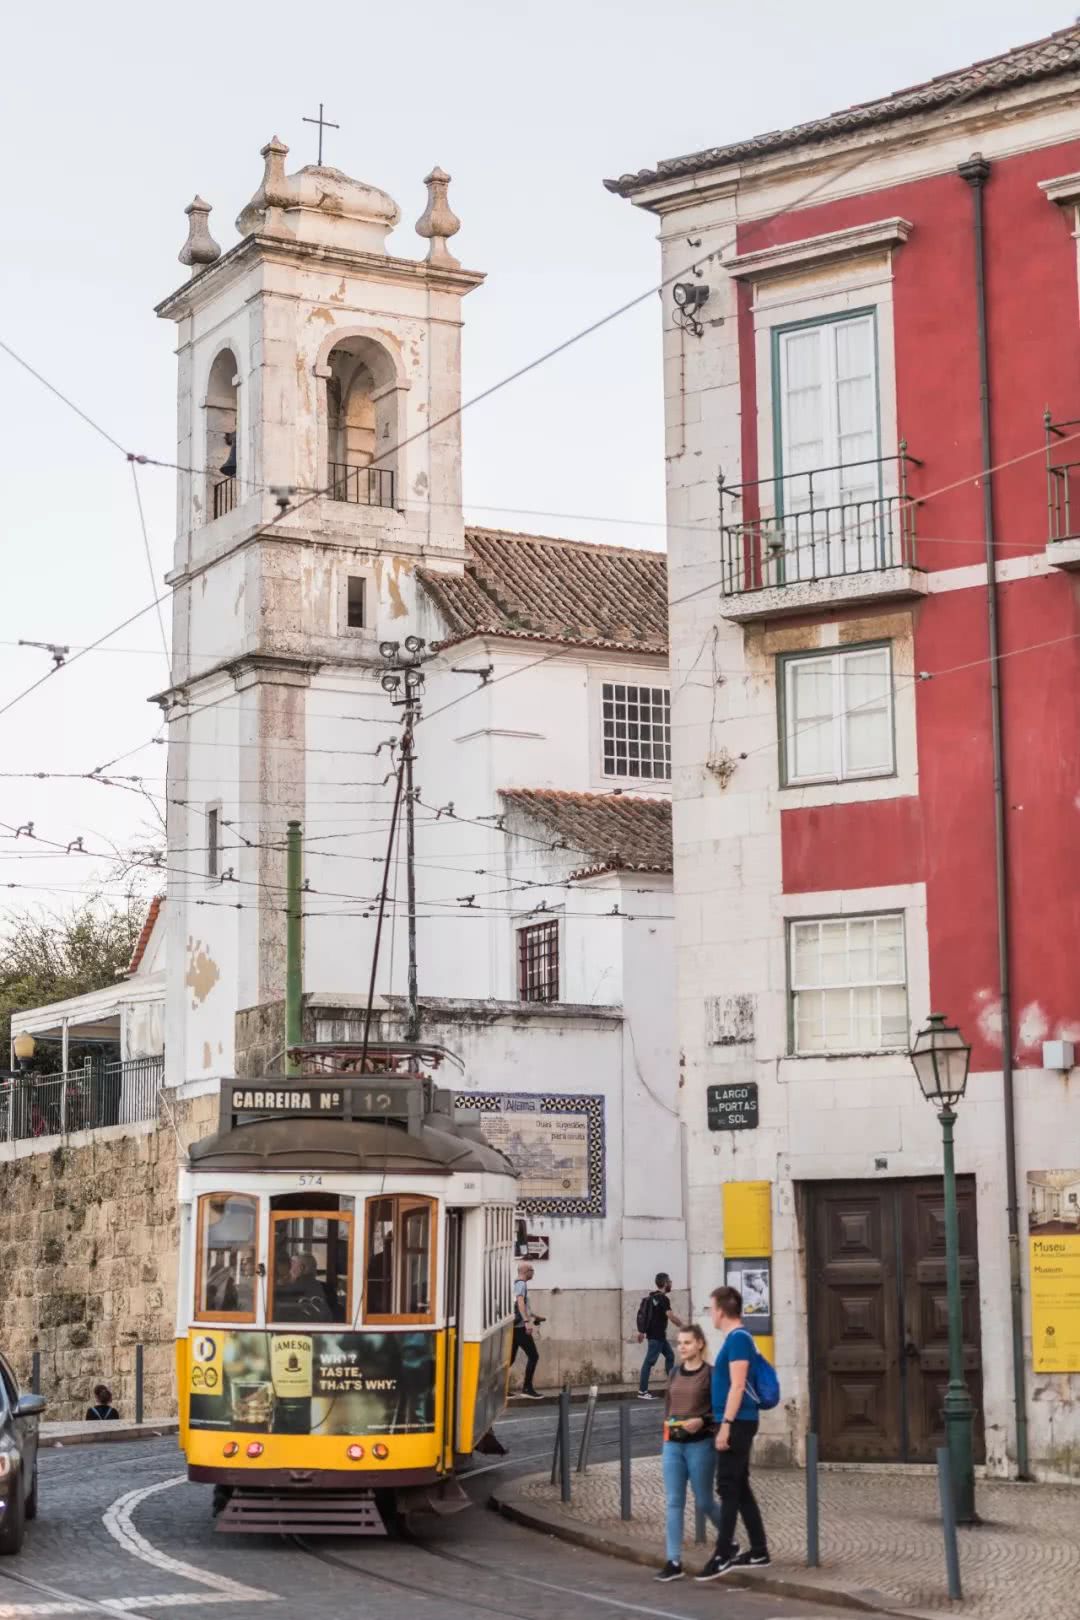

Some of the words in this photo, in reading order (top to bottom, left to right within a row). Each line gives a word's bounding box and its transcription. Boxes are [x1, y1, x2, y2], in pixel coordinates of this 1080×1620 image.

[232, 1091, 311, 1109] CARREIRA
[715, 1089, 748, 1100] LARGO
[718, 1101, 757, 1112] PORTAS
[728, 1114, 748, 1124] SOL
[299, 1175, 322, 1186] 574
[1033, 1242, 1066, 1252] Museu
[320, 1366, 363, 1379] TASTE,
[320, 1380, 362, 1391] THAT'S
